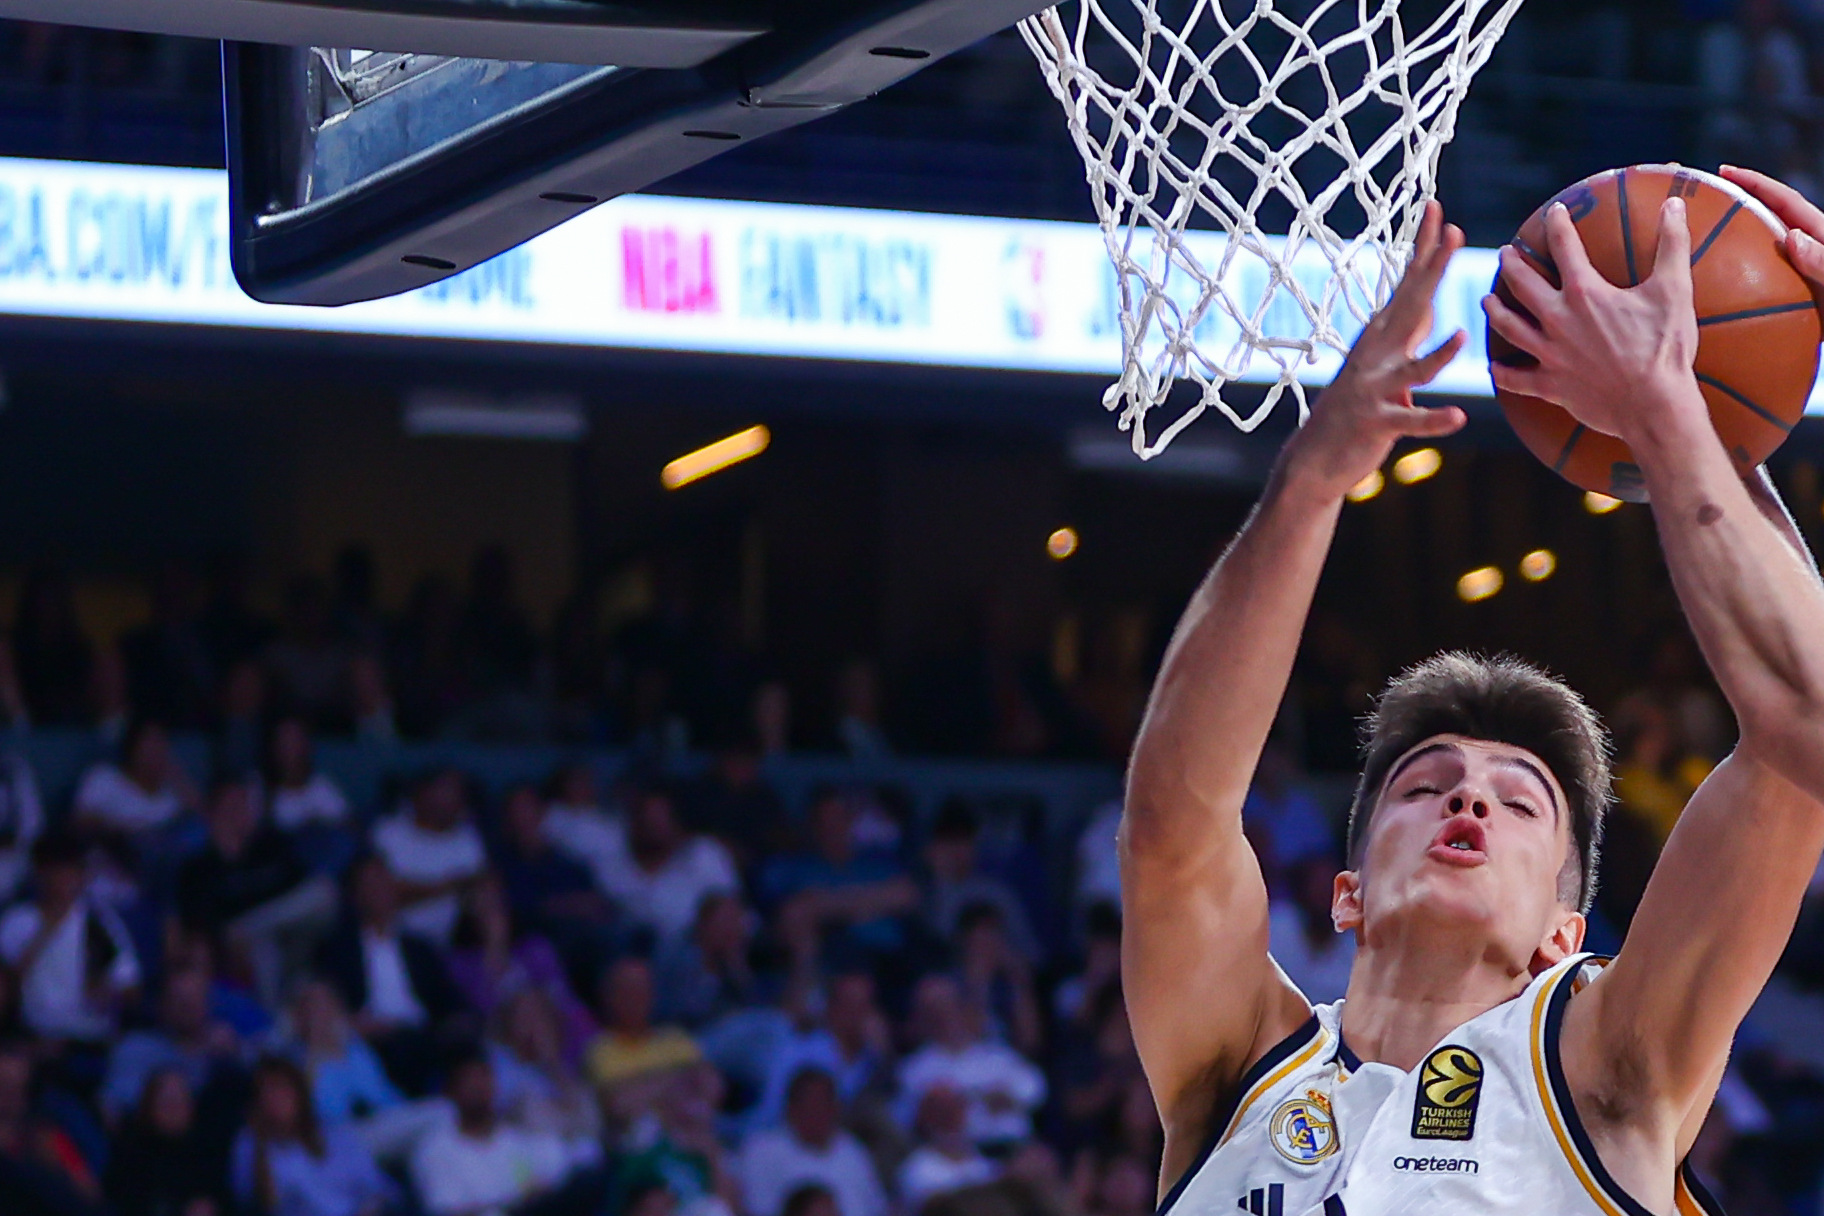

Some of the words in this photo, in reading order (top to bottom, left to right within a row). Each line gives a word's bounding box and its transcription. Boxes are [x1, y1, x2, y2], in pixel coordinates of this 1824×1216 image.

[1420, 1106, 1472, 1118] TURKISH
[1418, 1118, 1470, 1128] AIRLINES
[1393, 1155, 1480, 1174] oneteam
